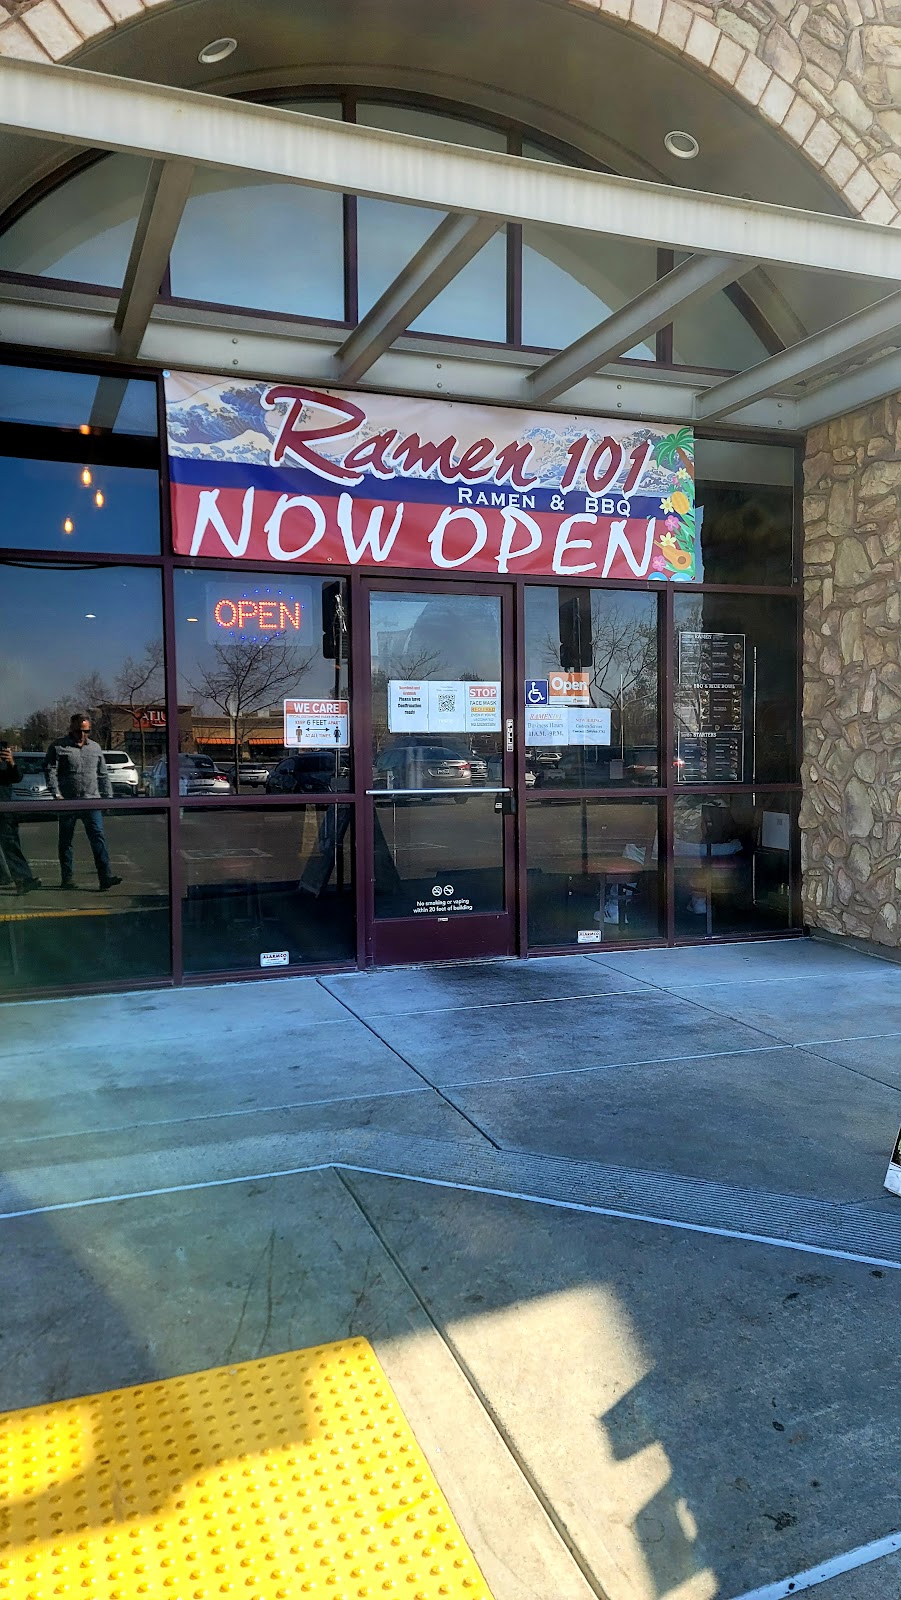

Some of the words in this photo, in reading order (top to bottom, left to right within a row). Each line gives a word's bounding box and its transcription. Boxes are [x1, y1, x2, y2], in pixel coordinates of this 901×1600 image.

[261, 385, 540, 488] Ramen
[559, 437, 653, 499] 101
[457, 486, 536, 509] RAMEN
[549, 494, 565, 510] &
[584, 498, 632, 518] BBQ
[189, 486, 404, 564] NOW
[427, 506, 658, 578] OPEN
[214, 599, 301, 630] OPEN
[469, 688, 497, 697] STOP
[551, 676, 588, 694] Open
[293, 702, 310, 713] WE
[312, 703, 340, 714] CARE
